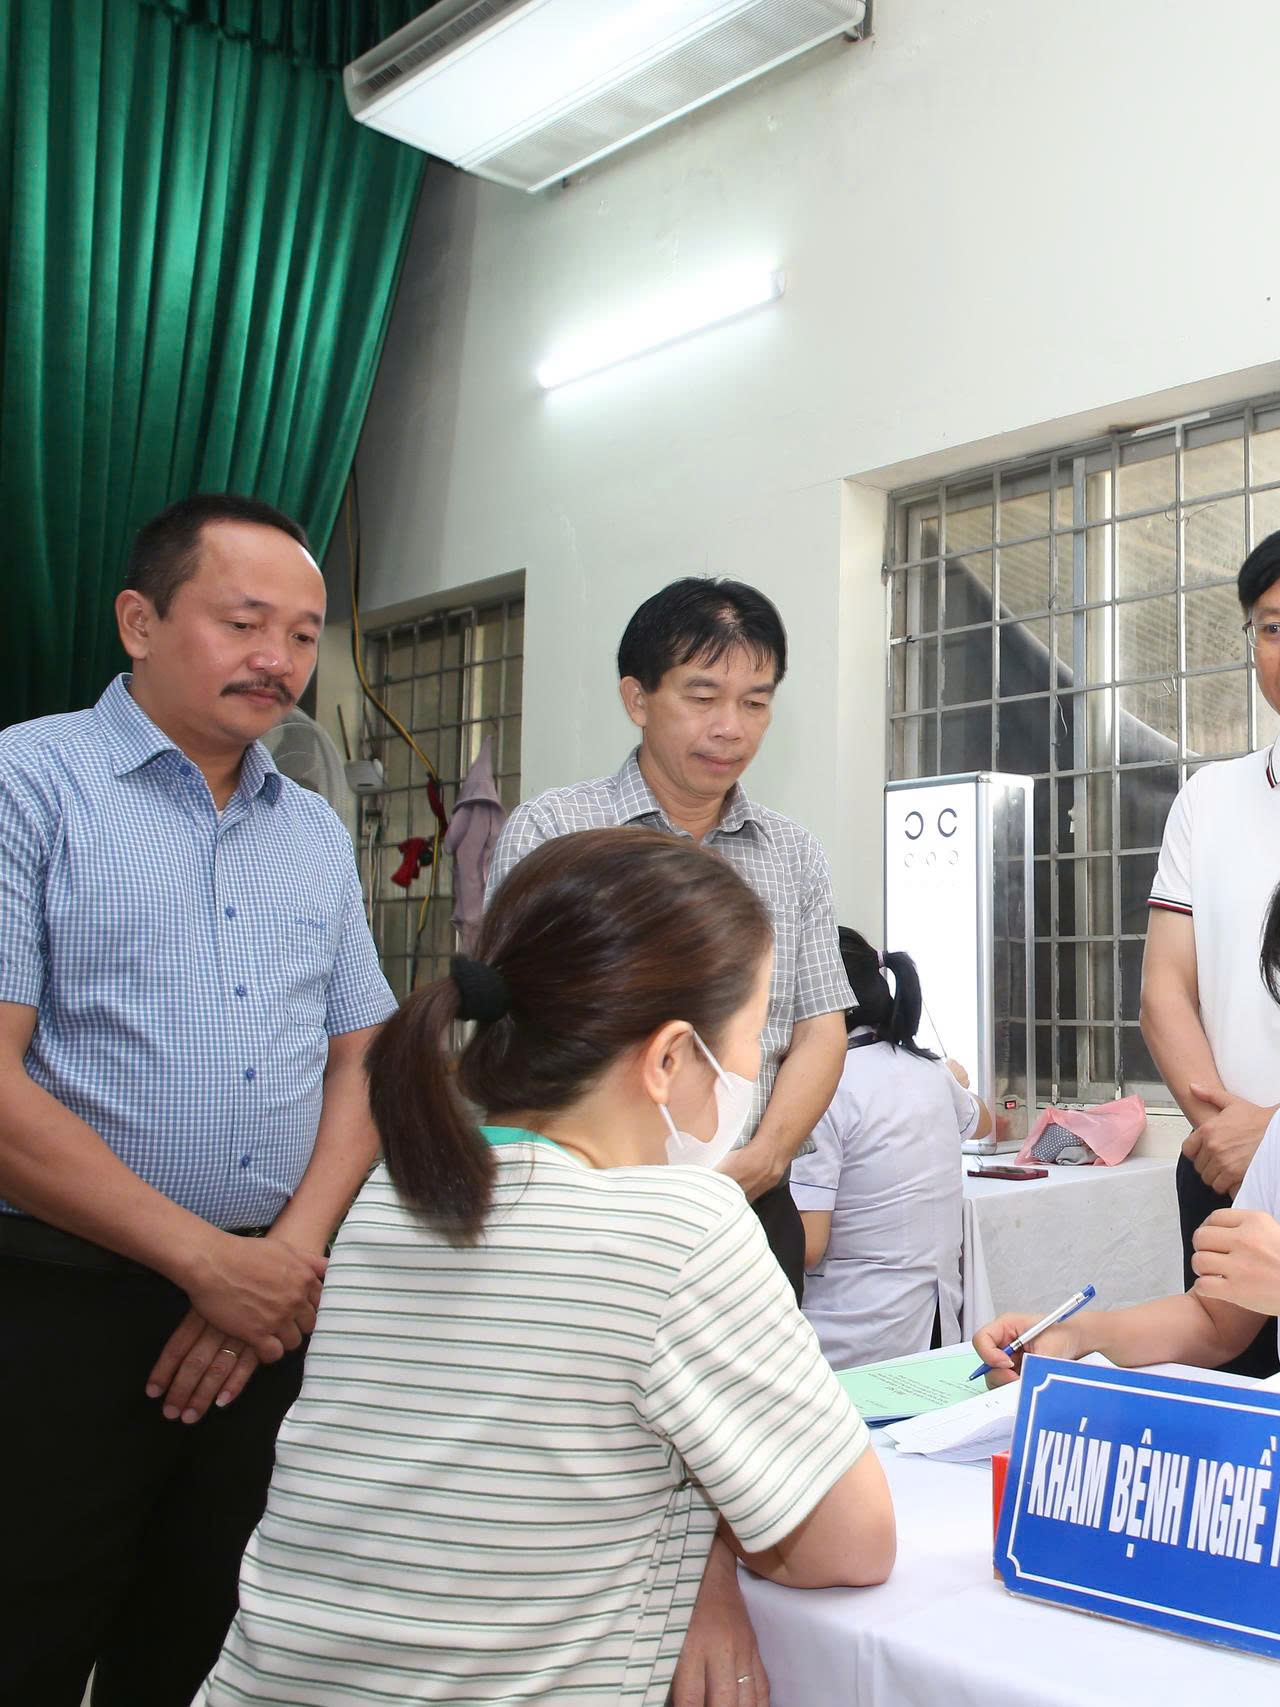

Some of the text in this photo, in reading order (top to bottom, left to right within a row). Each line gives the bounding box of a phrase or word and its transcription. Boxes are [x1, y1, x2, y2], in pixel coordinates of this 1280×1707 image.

[1027, 1416, 1112, 1529] KHÁM
[1108, 1428, 1190, 1558] BỆNH
[1186, 1436, 1279, 1564] NGHỀ
